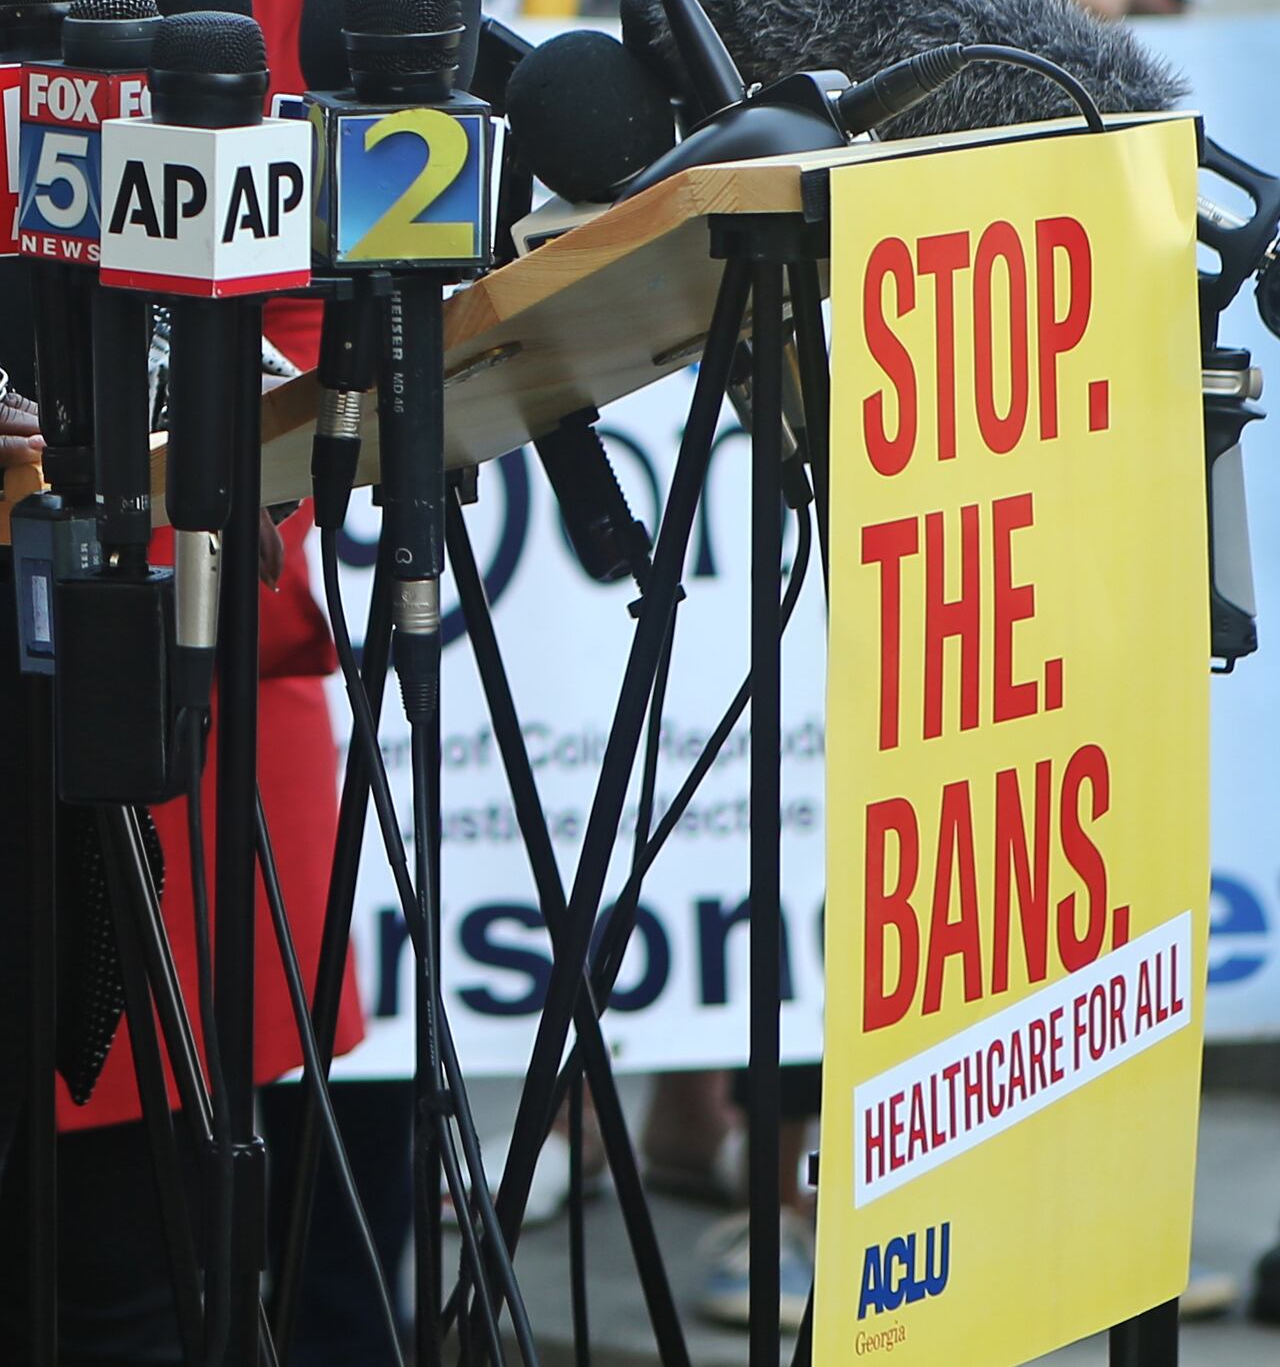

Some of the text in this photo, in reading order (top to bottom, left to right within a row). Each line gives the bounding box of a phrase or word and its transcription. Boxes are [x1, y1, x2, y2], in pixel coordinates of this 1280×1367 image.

[28, 72, 101, 124] FOX
[35, 131, 90, 229] 5
[108, 159, 208, 240] AP
[221, 160, 304, 244] AP
[345, 107, 474, 262] 2
[21, 234, 101, 262] NEWS
[390, 289, 403, 362] HEISER
[862, 216, 1110, 477] STOP.
[860, 492, 1065, 752] THE.
[862, 743, 1130, 1034] BANS.
[864, 942, 1185, 1186] HEALTHCARE FOR ALL
[856, 1220, 952, 1322] ACLU
[855, 1319, 908, 1357] Georgia
